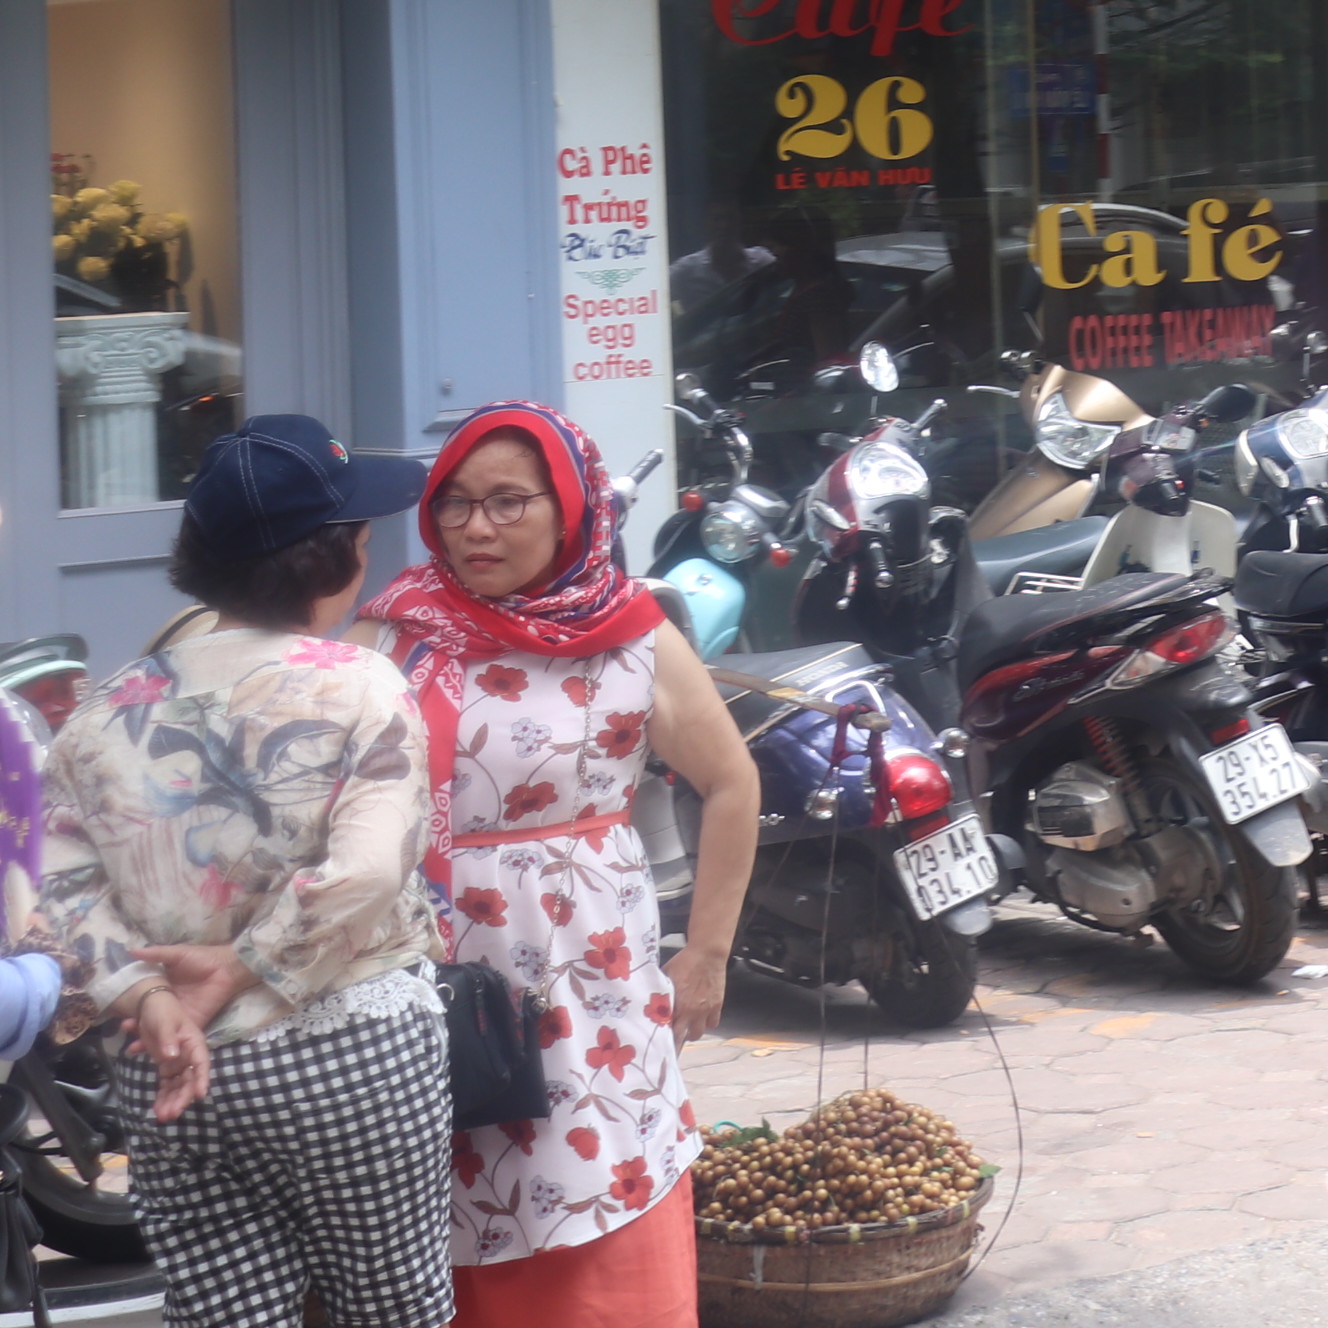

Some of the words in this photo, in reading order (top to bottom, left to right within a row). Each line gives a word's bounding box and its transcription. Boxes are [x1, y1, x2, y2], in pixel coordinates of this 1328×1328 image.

[774, 74, 934, 162] 26
[557, 147, 592, 179] Cà
[599, 143, 653, 177] Phê
[562, 189, 650, 230] Trứng
[1027, 197, 1284, 290] Café
[562, 289, 658, 324] Special
[587, 323, 636, 350] egg
[1068, 312, 1154, 371] COFFEE
[573, 353, 653, 381] coffee
[1215, 734, 1280, 784] 29-X5
[1222, 760, 1298, 816] 354.27
[908, 826, 978, 879] 29-AA
[916, 854, 996, 913] 034.10
